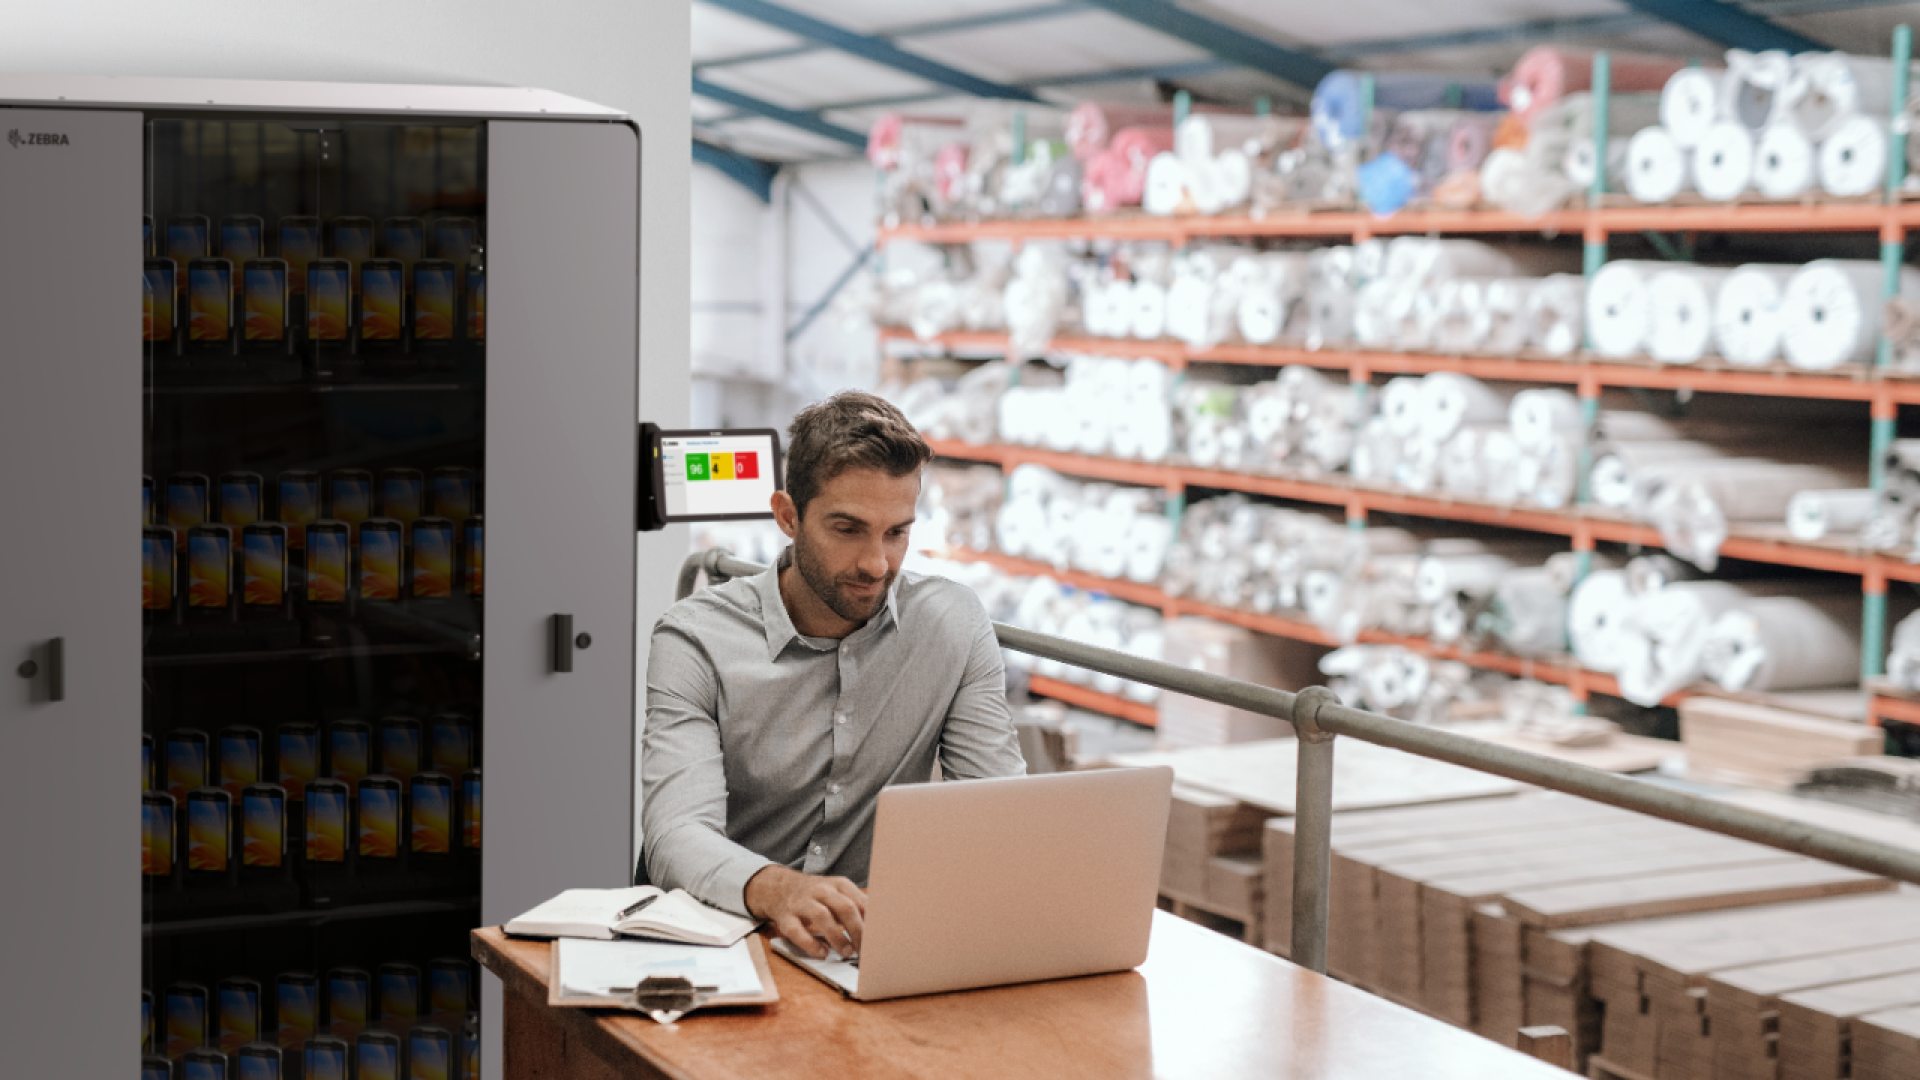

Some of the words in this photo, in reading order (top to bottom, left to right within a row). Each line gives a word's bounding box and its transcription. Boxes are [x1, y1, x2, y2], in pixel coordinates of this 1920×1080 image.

[28, 133, 69, 145] ZEBRA
[690, 464, 703, 475] 96
[711, 463, 719, 475] 4
[736, 462, 744, 474] 0
